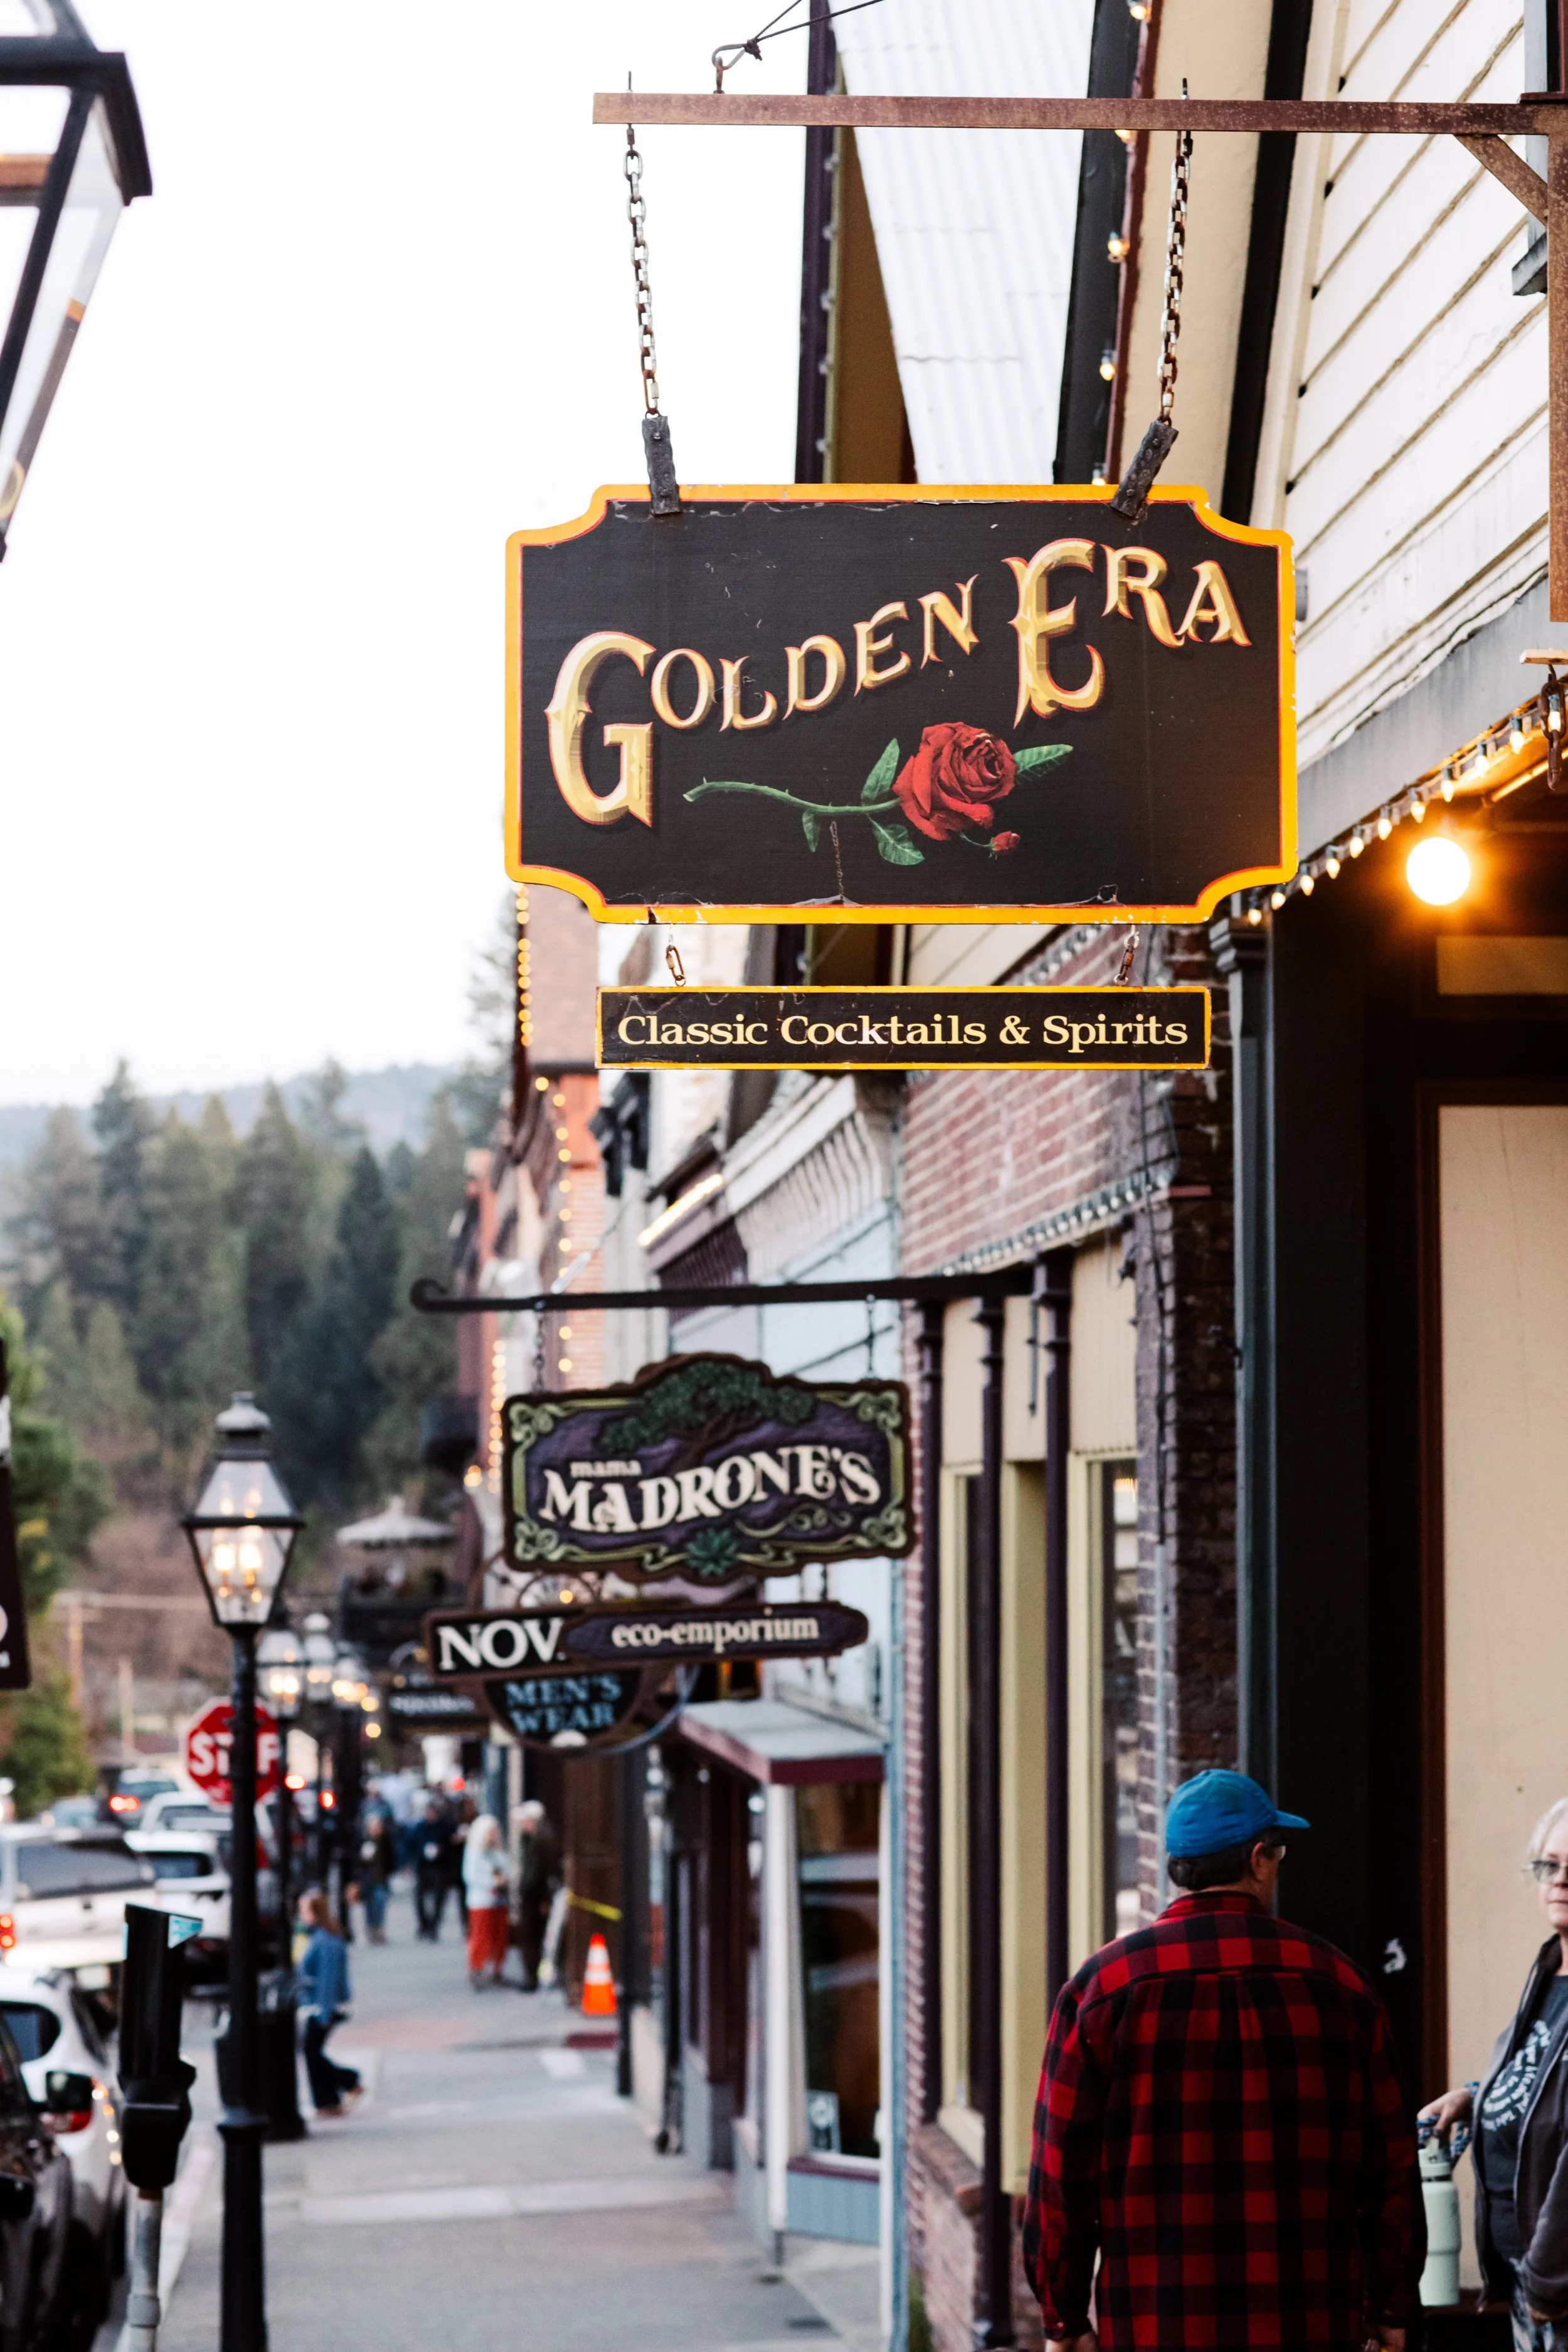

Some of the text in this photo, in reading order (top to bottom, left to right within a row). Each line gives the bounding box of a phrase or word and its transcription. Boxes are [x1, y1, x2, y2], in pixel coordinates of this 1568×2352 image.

[618, 1013, 1188, 1054] Classic Cocktails & Spirits
[538, 1444, 881, 1534] MADRONE'S
[569, 1459, 642, 1478] mama
[437, 1617, 566, 1671] NOV
[611, 1606, 820, 1654] eco-emporium
[505, 1674, 622, 1706] MEN'S
[509, 1702, 616, 1734] WEAR
[191, 1731, 280, 1777] STP
